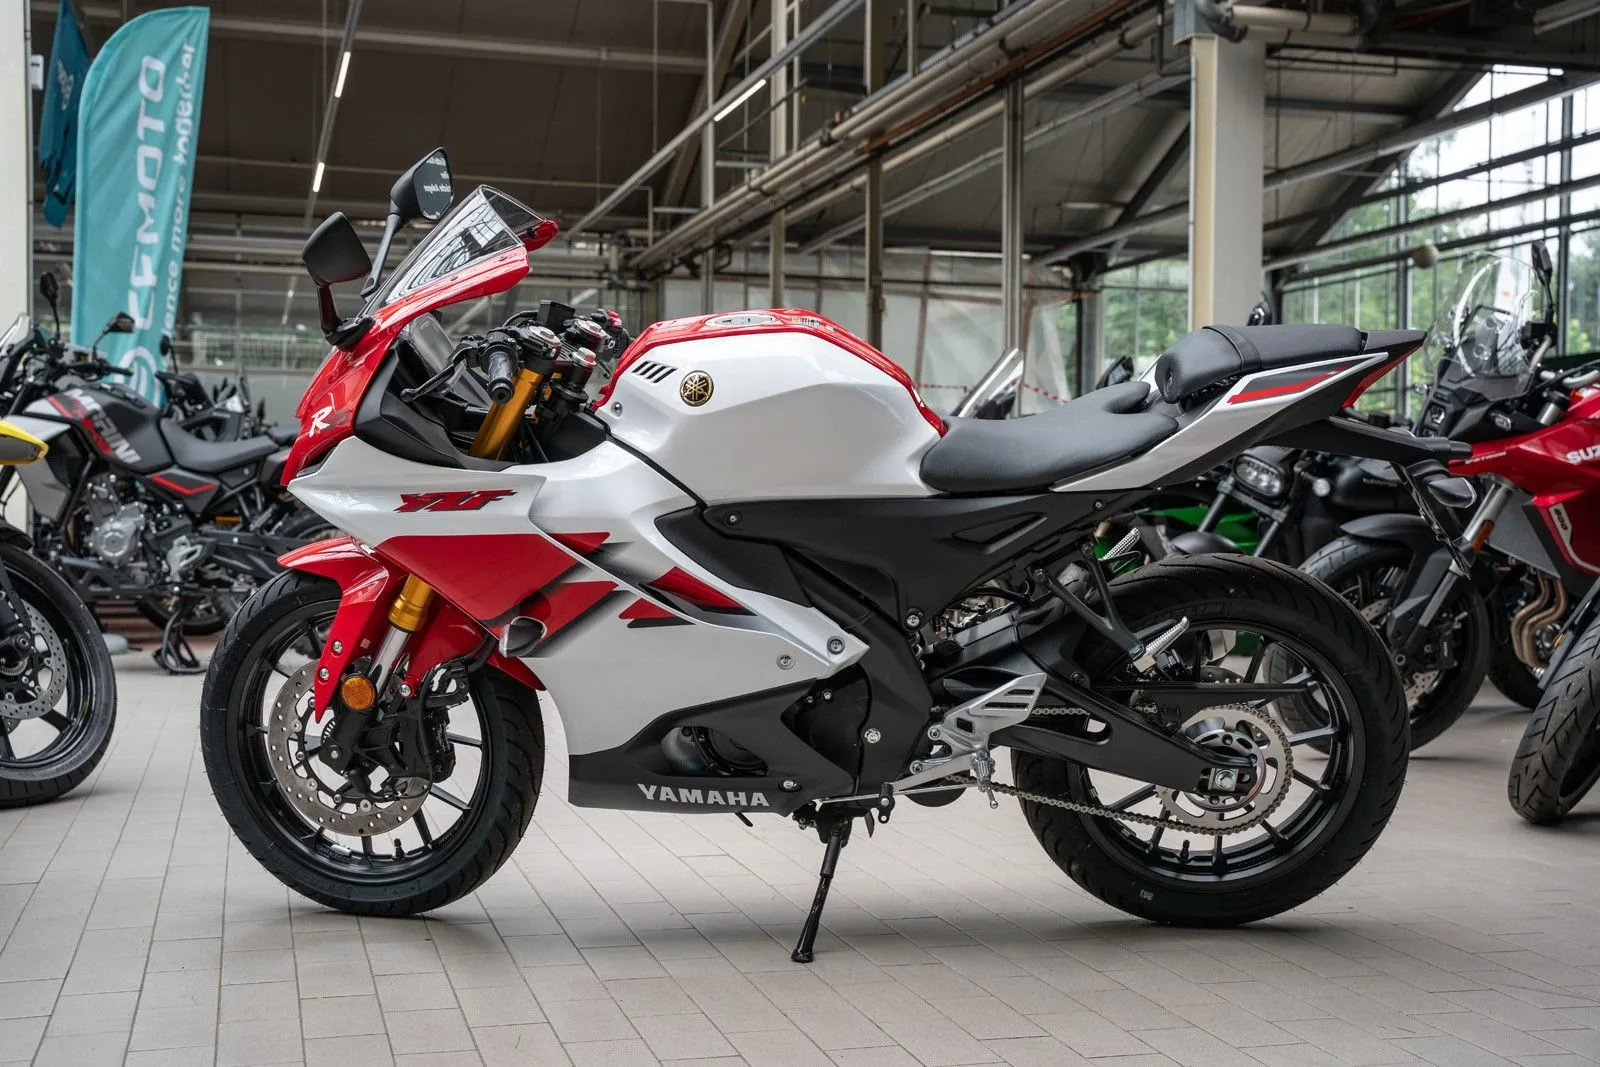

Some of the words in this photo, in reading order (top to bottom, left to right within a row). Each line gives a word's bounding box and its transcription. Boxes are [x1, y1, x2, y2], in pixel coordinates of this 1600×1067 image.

[63, 387, 143, 465] MORINI
[392, 489, 519, 514] YZF
[637, 783, 770, 807] YAMAHA
